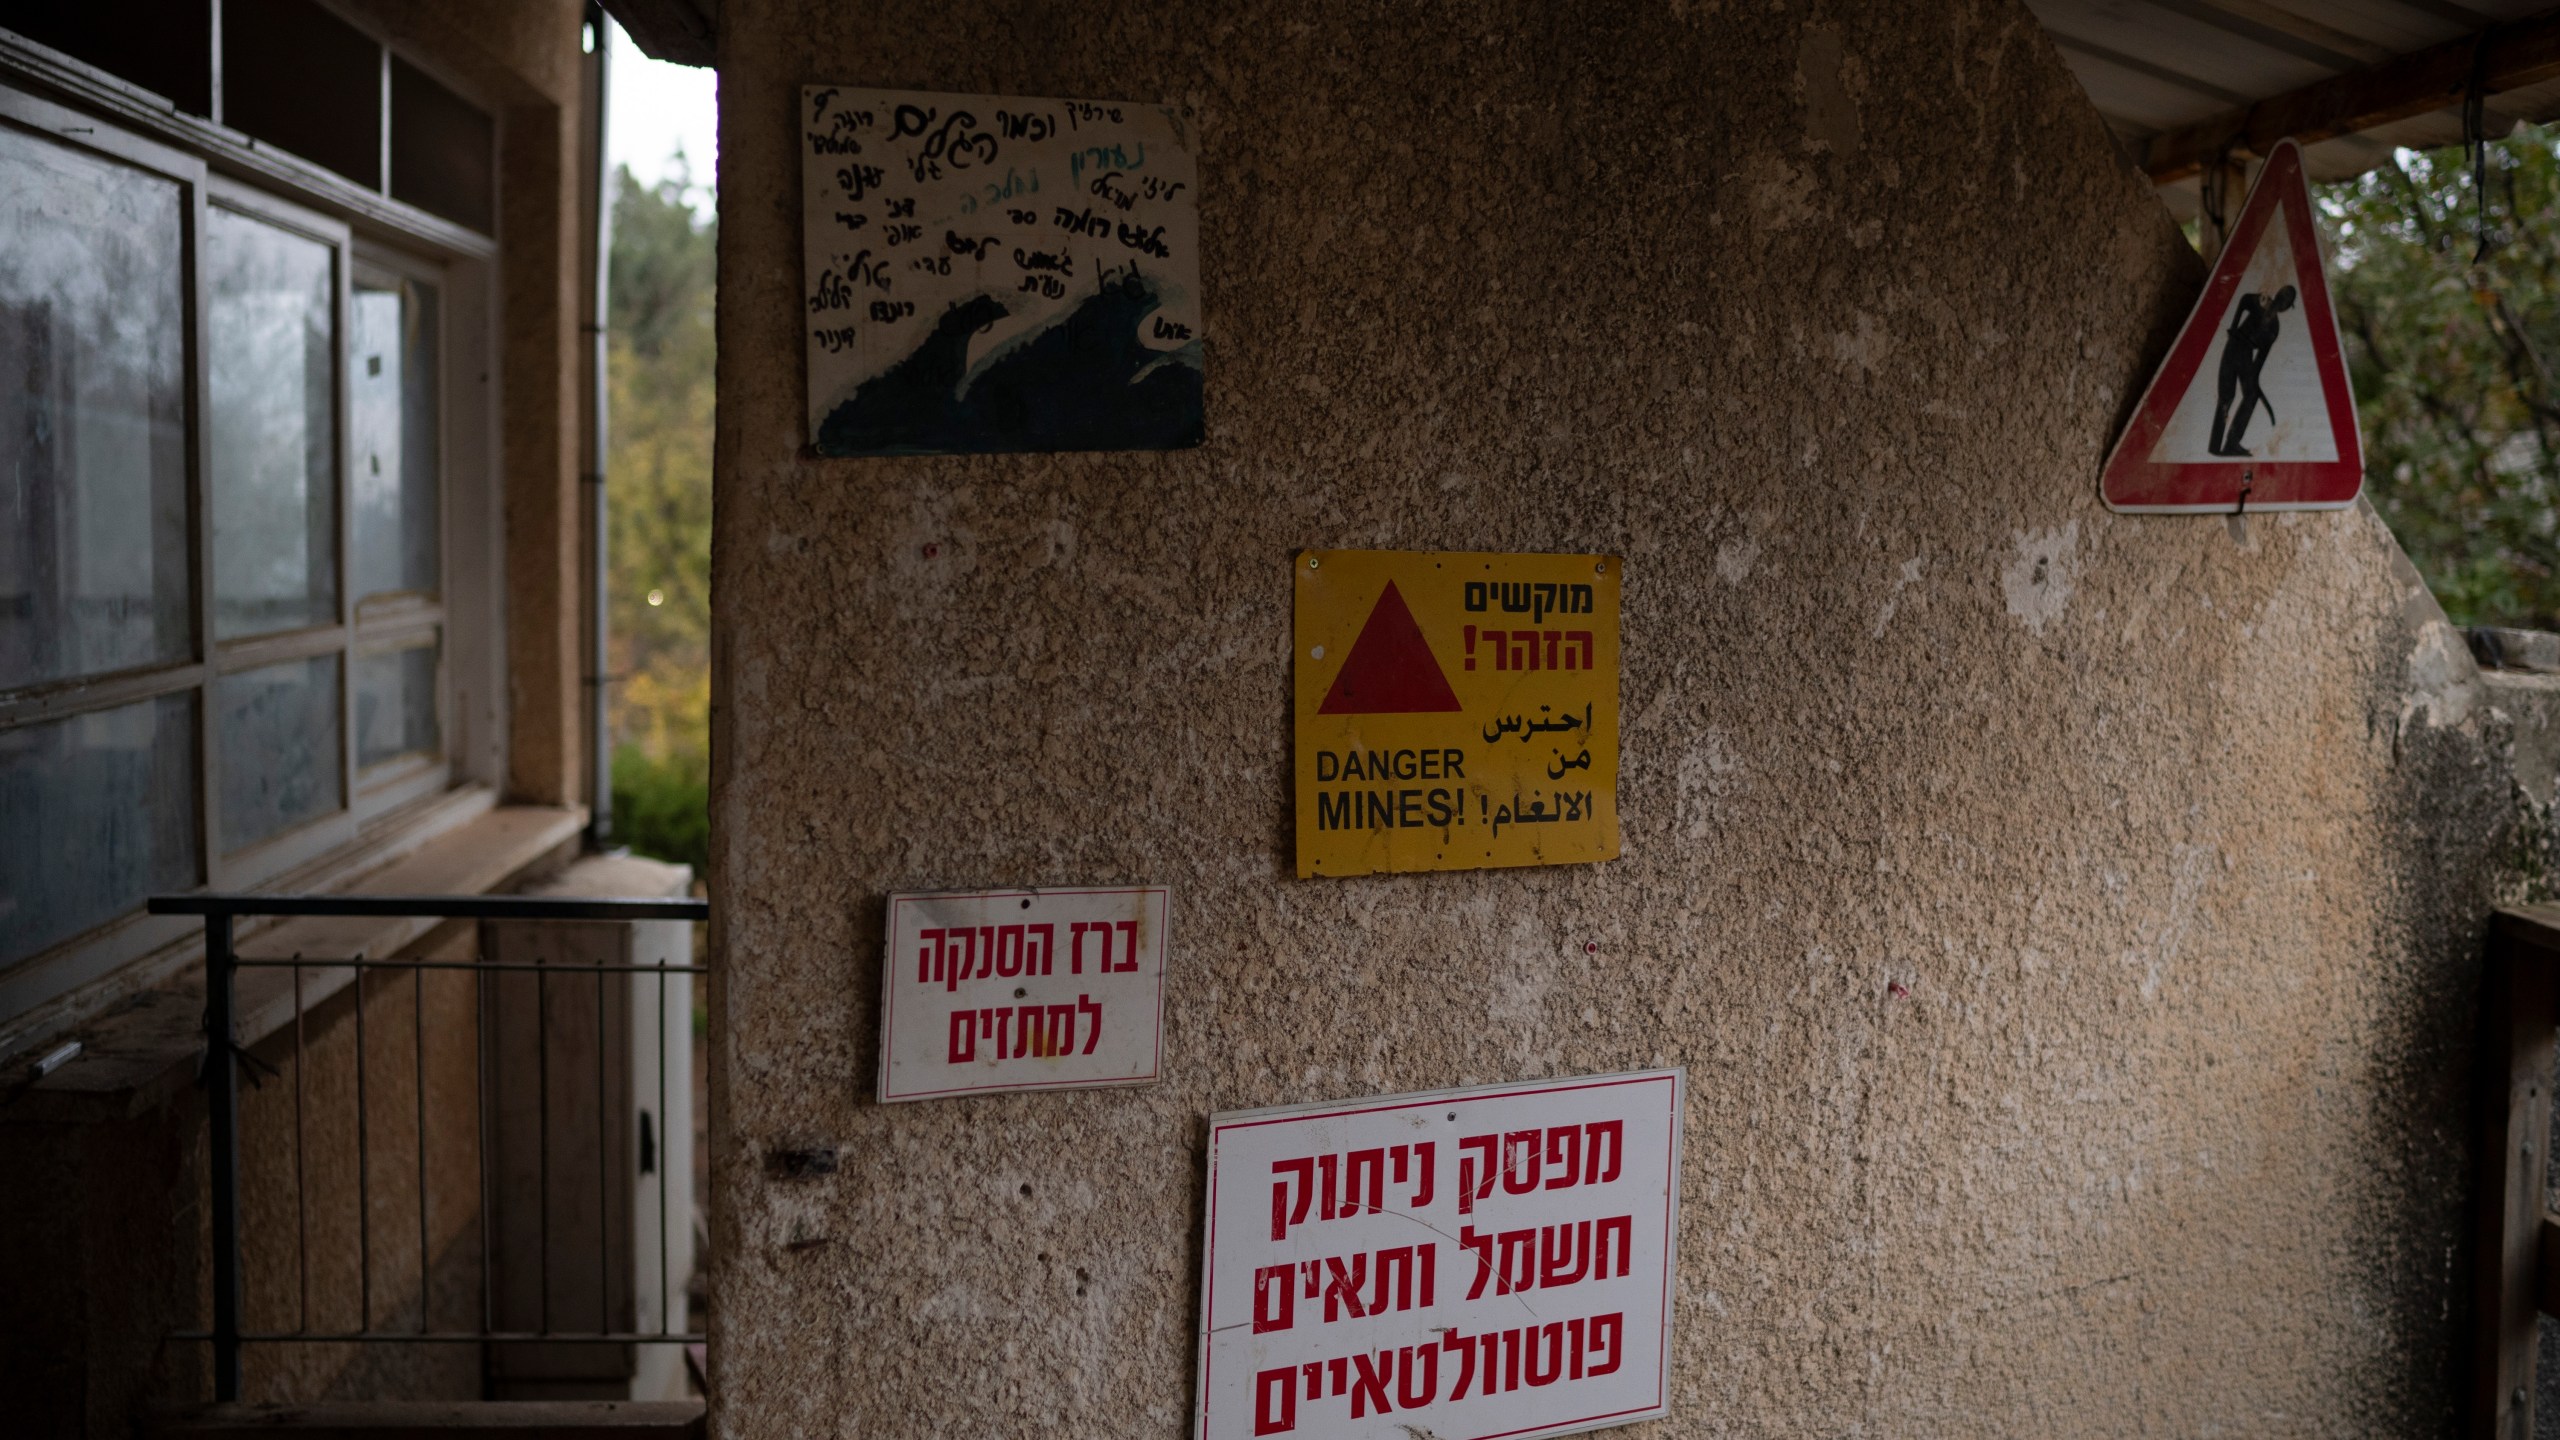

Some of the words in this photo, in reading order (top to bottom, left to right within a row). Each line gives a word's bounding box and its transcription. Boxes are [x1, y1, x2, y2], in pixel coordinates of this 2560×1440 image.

[886, 105, 998, 169] הגלים
[1464, 581, 1594, 624] מוקשים
[1463, 624, 1594, 672] הזהר!
[1482, 701, 1593, 743] احترس
[1316, 748, 1466, 782] DANGER
[1547, 748, 1592, 780] من
[1317, 788, 1465, 831] MINES!
[918, 922, 1054, 993] הסנקה
[1070, 920, 1139, 975] ברז
[948, 993, 1102, 1064] למתזים
[1270, 1141, 1436, 1242] ניתוק
[1458, 1119, 1624, 1215] מפסק
[1252, 1242, 1436, 1335] ותאים
[1459, 1214, 1632, 1301] חשמל
[1254, 1311, 1624, 1438] פוטוולטאיים
